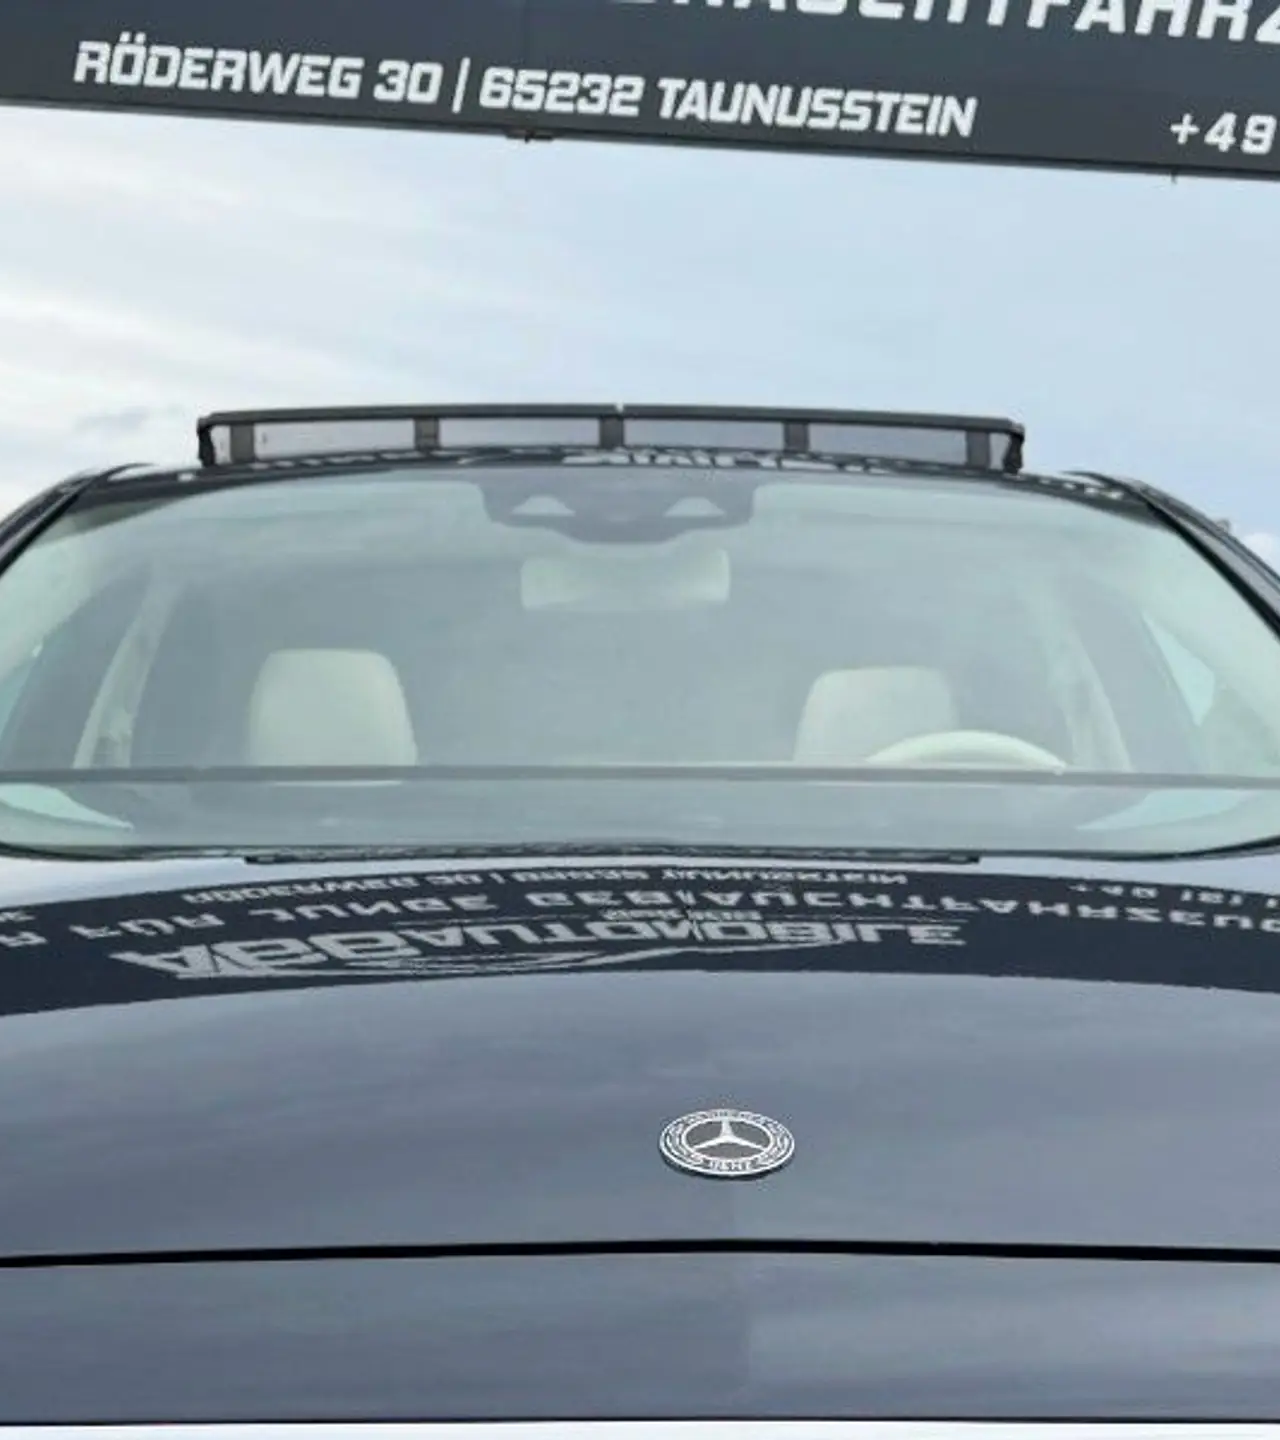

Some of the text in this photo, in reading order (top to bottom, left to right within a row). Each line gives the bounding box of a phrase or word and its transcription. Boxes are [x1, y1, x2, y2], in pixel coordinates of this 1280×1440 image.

[73, 31, 365, 99] RÖDERWEG
[373, 60, 444, 104] 30
[479, 67, 646, 117] 65232
[658, 77, 978, 138] TAUNUSSTEIN
[1170, 112, 1277, 154] +49
